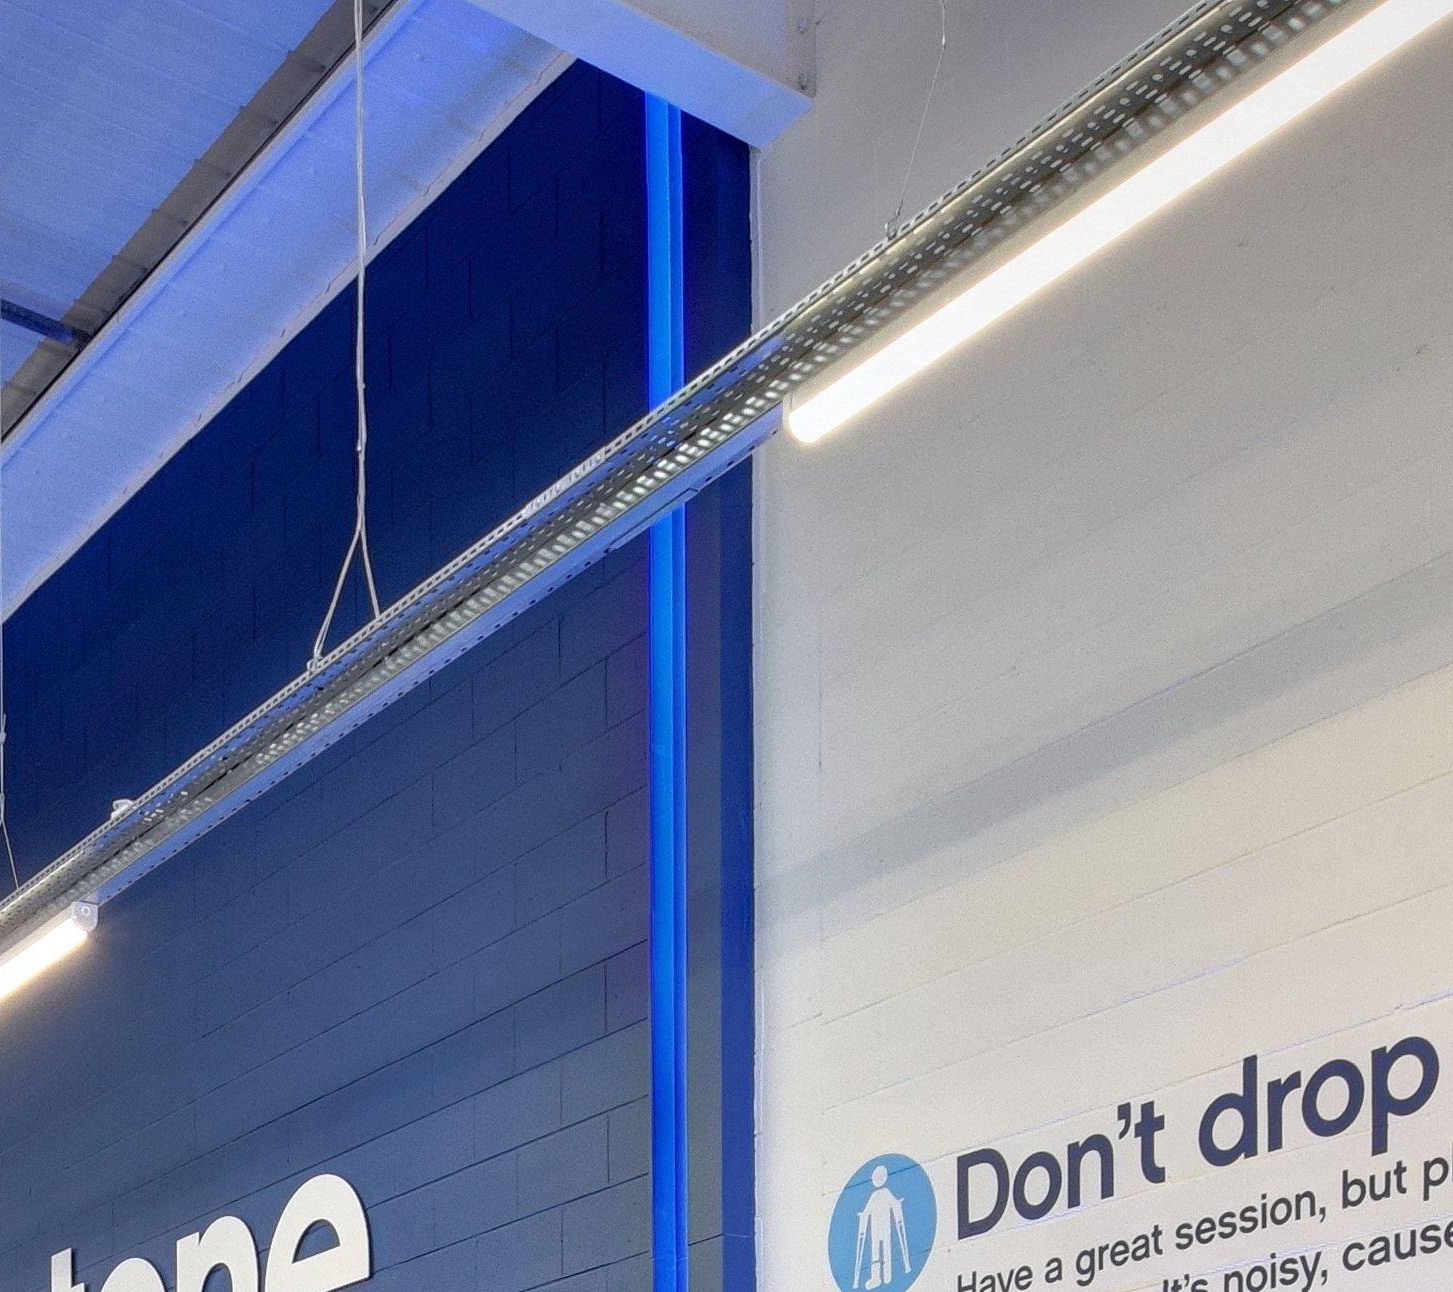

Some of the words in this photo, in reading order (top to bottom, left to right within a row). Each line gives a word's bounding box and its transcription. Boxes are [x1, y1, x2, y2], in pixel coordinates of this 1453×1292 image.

[1198, 1034, 1440, 1168] drop
[1045, 1256, 1063, 1284] a
[1076, 1225, 1163, 1287] great
[1175, 1188, 1327, 1251] session,
[1341, 1160, 1408, 1209] but
